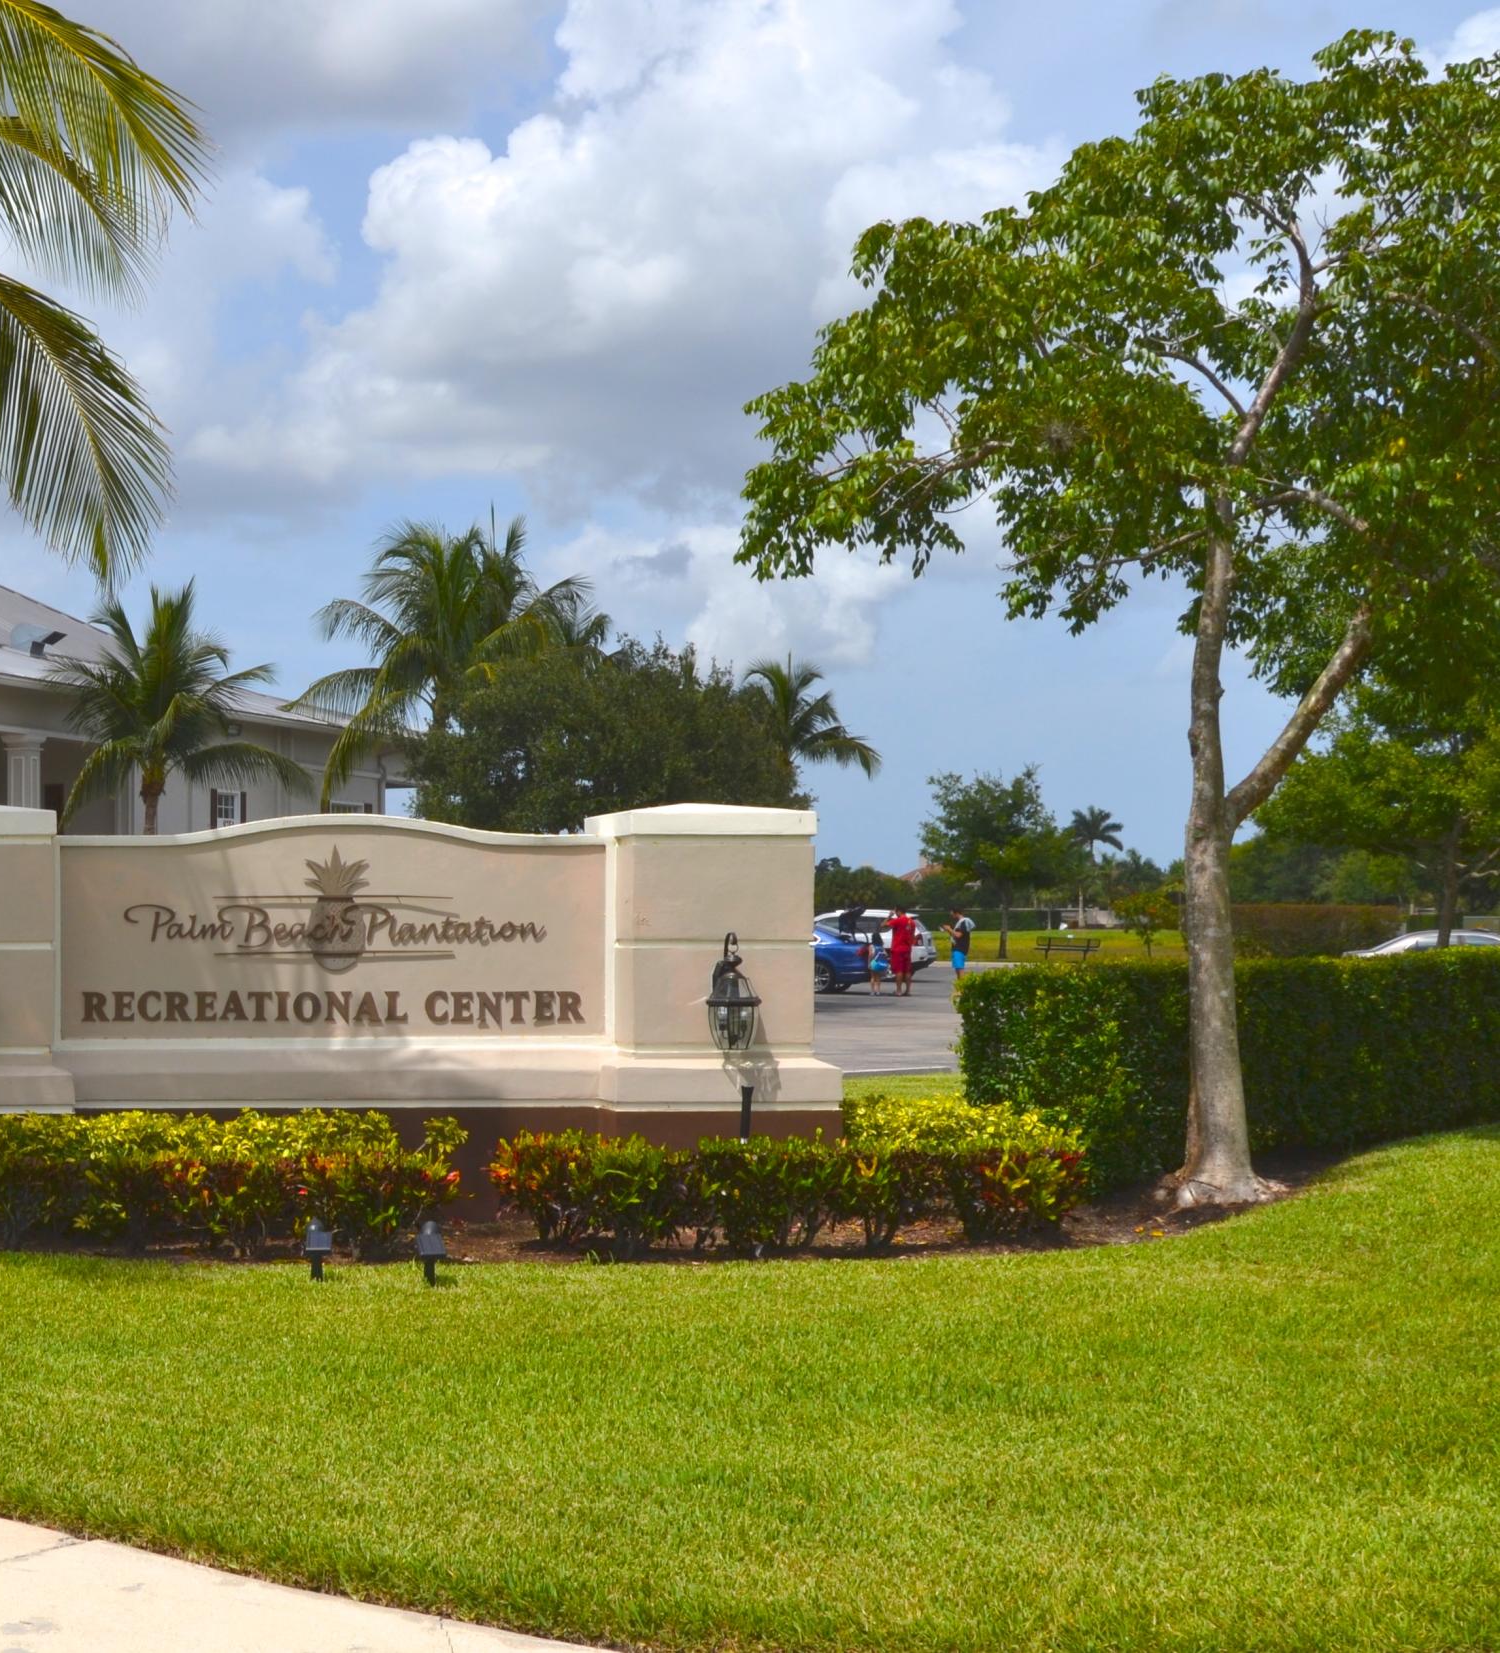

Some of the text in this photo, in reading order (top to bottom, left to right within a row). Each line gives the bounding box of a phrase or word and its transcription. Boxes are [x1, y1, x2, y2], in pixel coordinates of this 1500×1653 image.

[124, 903, 546, 948] Palm Beach Plantation
[81, 990, 586, 1029] RECREATIONAL CENTER
